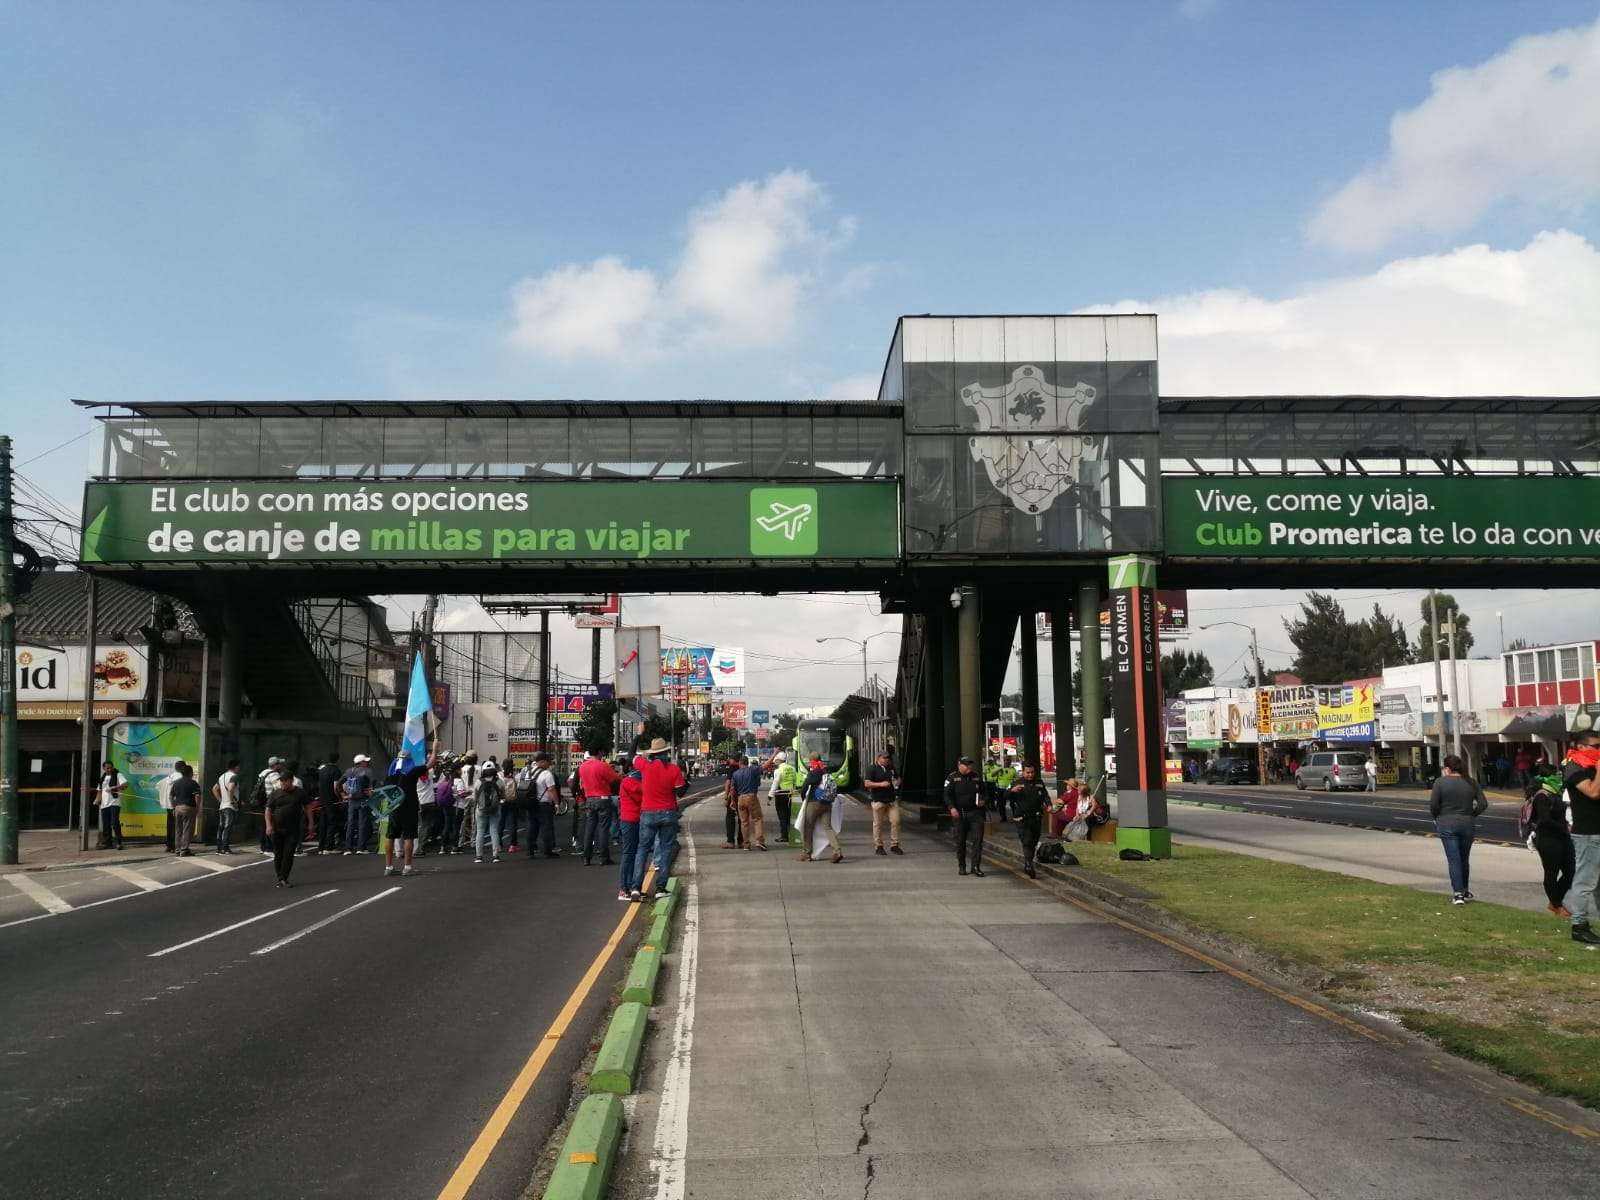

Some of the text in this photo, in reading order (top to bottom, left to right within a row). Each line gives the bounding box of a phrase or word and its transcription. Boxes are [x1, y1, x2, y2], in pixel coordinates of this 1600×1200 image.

[151, 487, 528, 516] El club con más opciones
[1196, 488, 1435, 517] Vive, come y viaja.
[148, 521, 691, 559] de canje de millas para viajar
[1196, 522, 1263, 546] Club
[1270, 521, 1412, 546] Promerica
[1419, 523, 1445, 545] te
[1453, 522, 1477, 545] lo
[1485, 522, 1515, 545] da
[1523, 528, 1572, 545] con
[1117, 595, 1129, 672] EL CARMEN
[1143, 595, 1153, 672] EL CARMEN
[1321, 713, 1352, 723] MAGNUM
